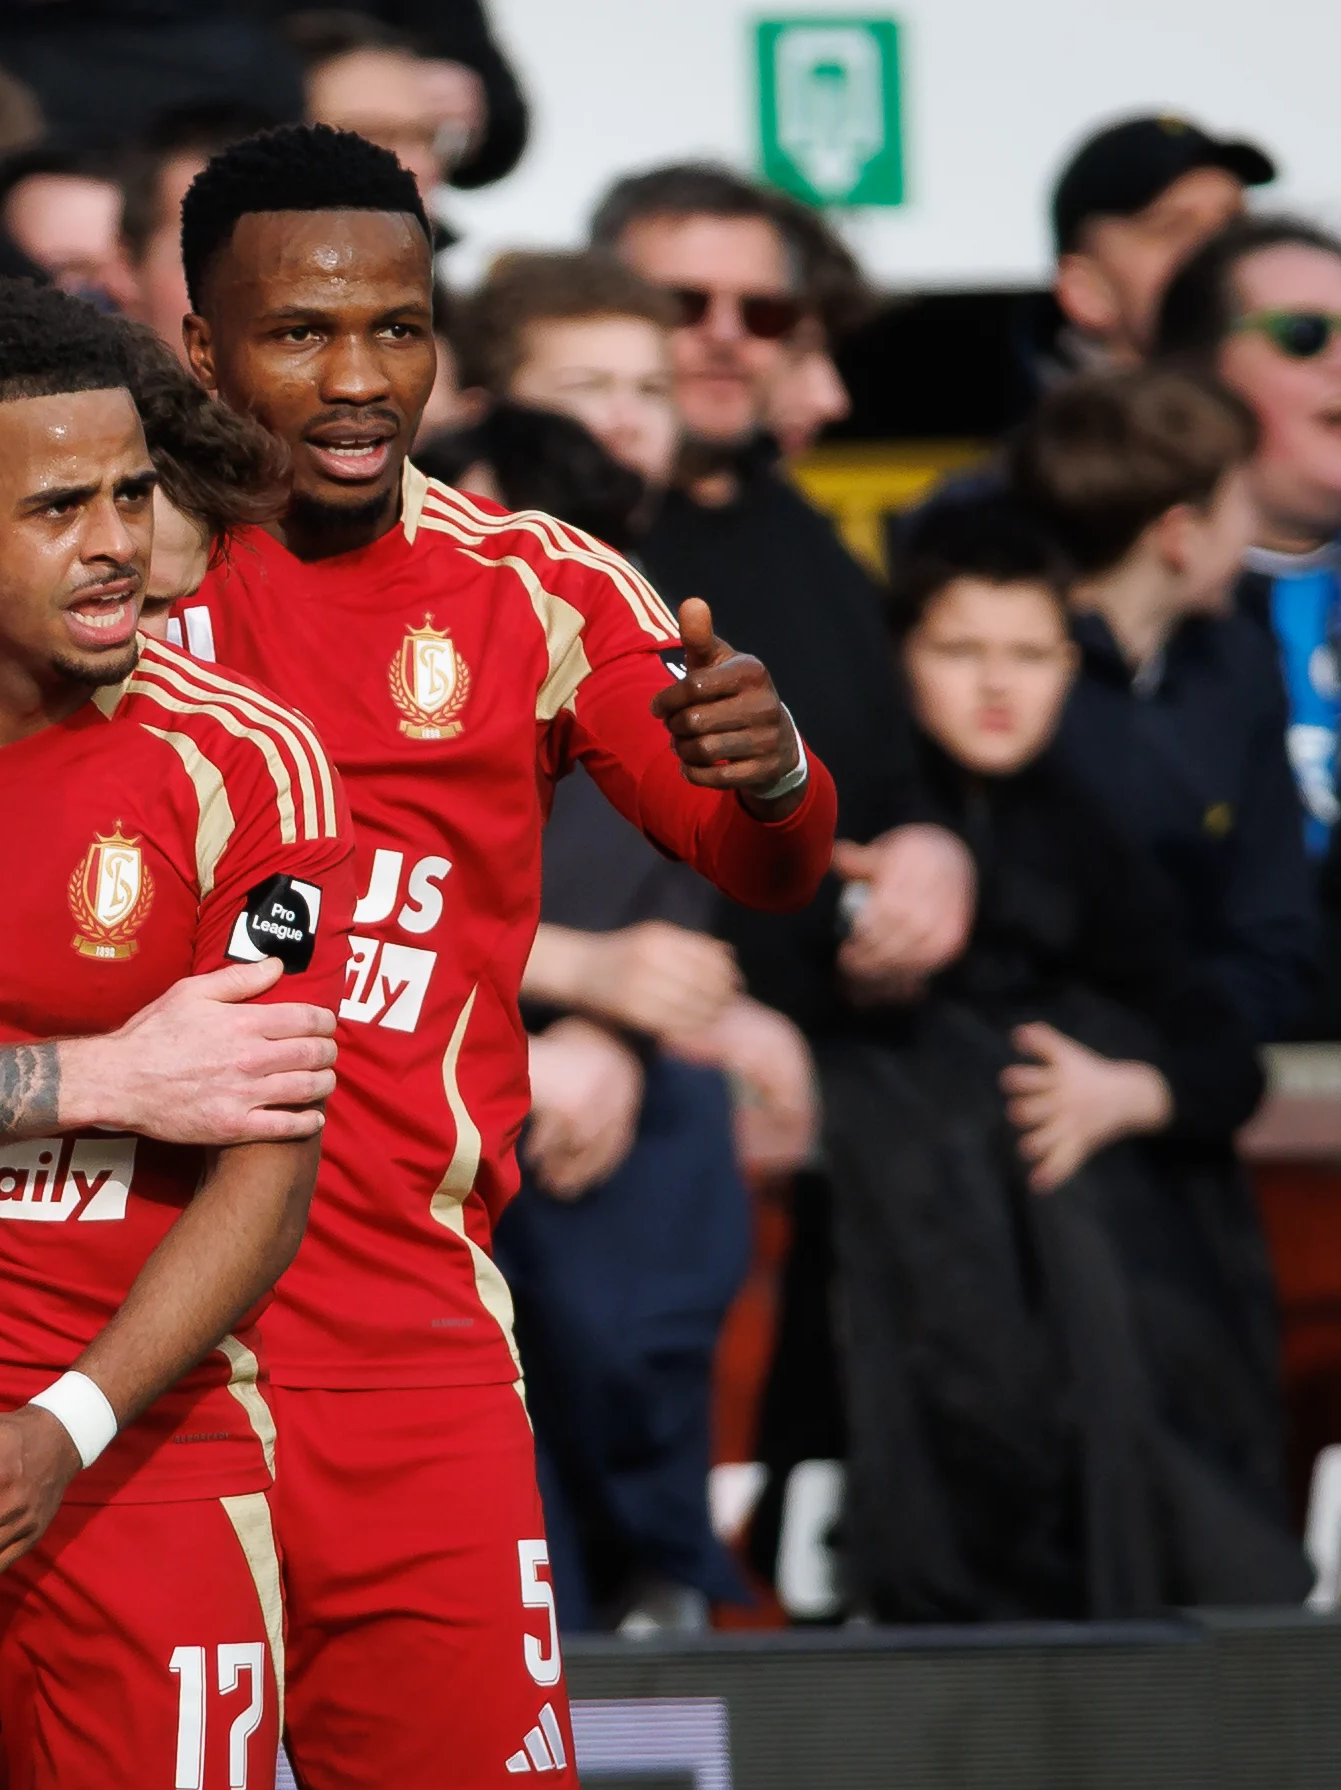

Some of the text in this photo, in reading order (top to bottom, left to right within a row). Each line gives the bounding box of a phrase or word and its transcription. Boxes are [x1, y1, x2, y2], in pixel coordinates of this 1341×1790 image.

[252, 914, 304, 941] League
[271, 903, 296, 922] Pro
[517, 1539, 562, 1687] 5
[169, 1642, 265, 1790] 17
